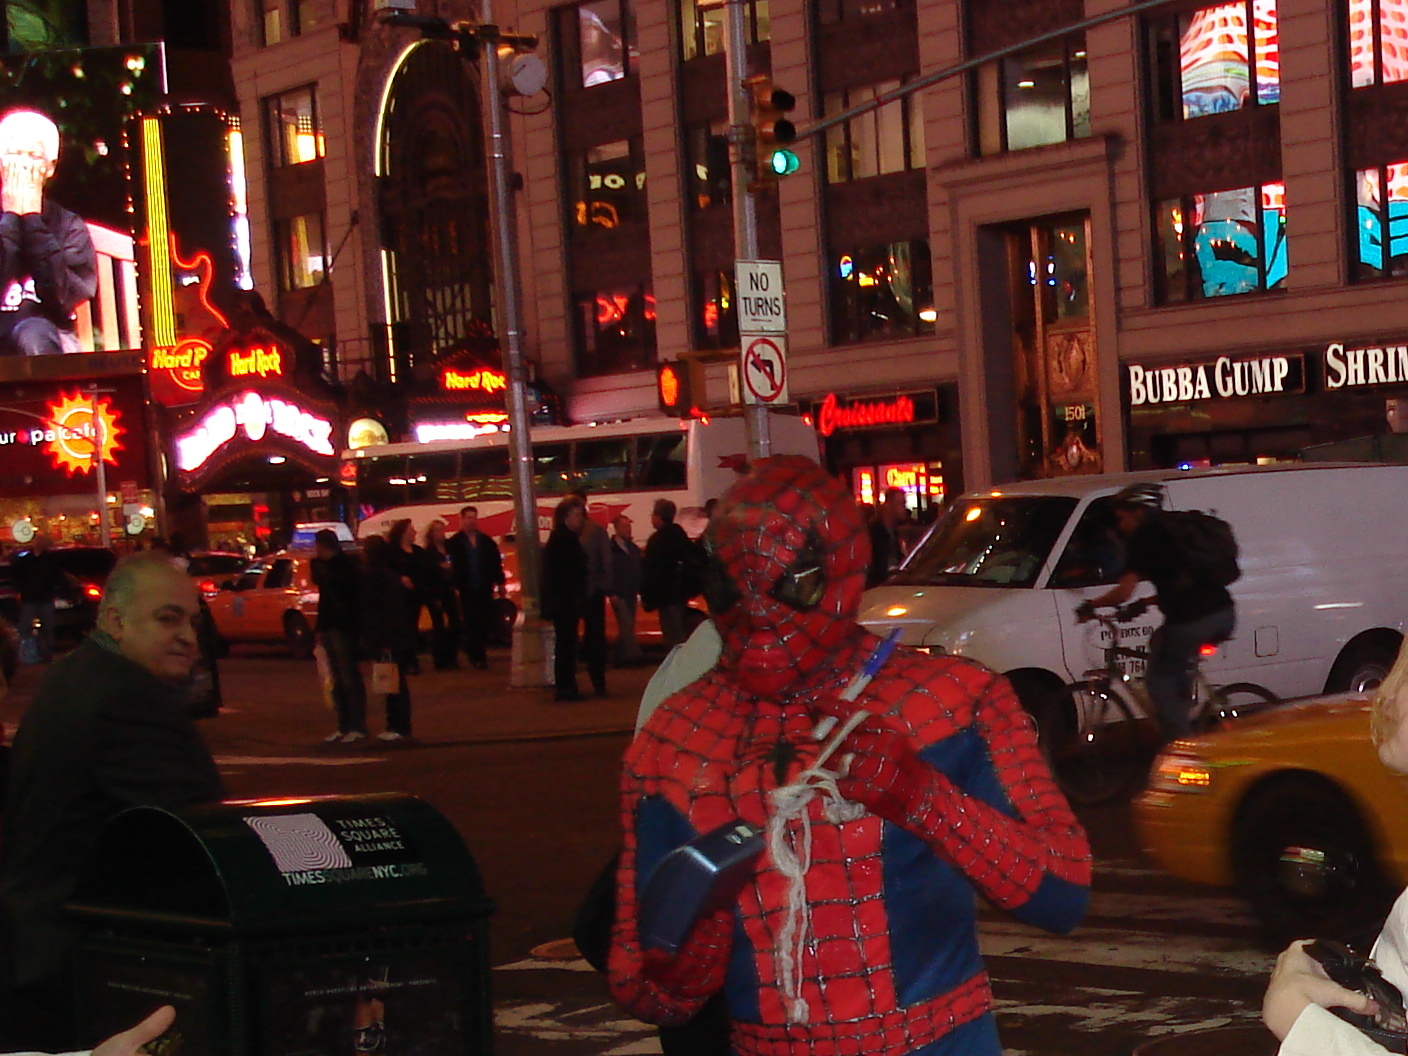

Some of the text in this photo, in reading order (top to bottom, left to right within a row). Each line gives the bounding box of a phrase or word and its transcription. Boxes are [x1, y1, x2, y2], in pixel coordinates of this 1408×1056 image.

[749, 272, 769, 291] NO
[741, 296, 781, 316] TURNS
[481, 370, 507, 393] Roc
[1129, 364, 1211, 406] BUBBA
[1214, 355, 1289, 398] GUMP
[1064, 404, 1086, 421] 1501
[335, 817, 387, 829] TIMES
[341, 828, 402, 842] SQUARE
[353, 840, 406, 853] ALLIANCE
